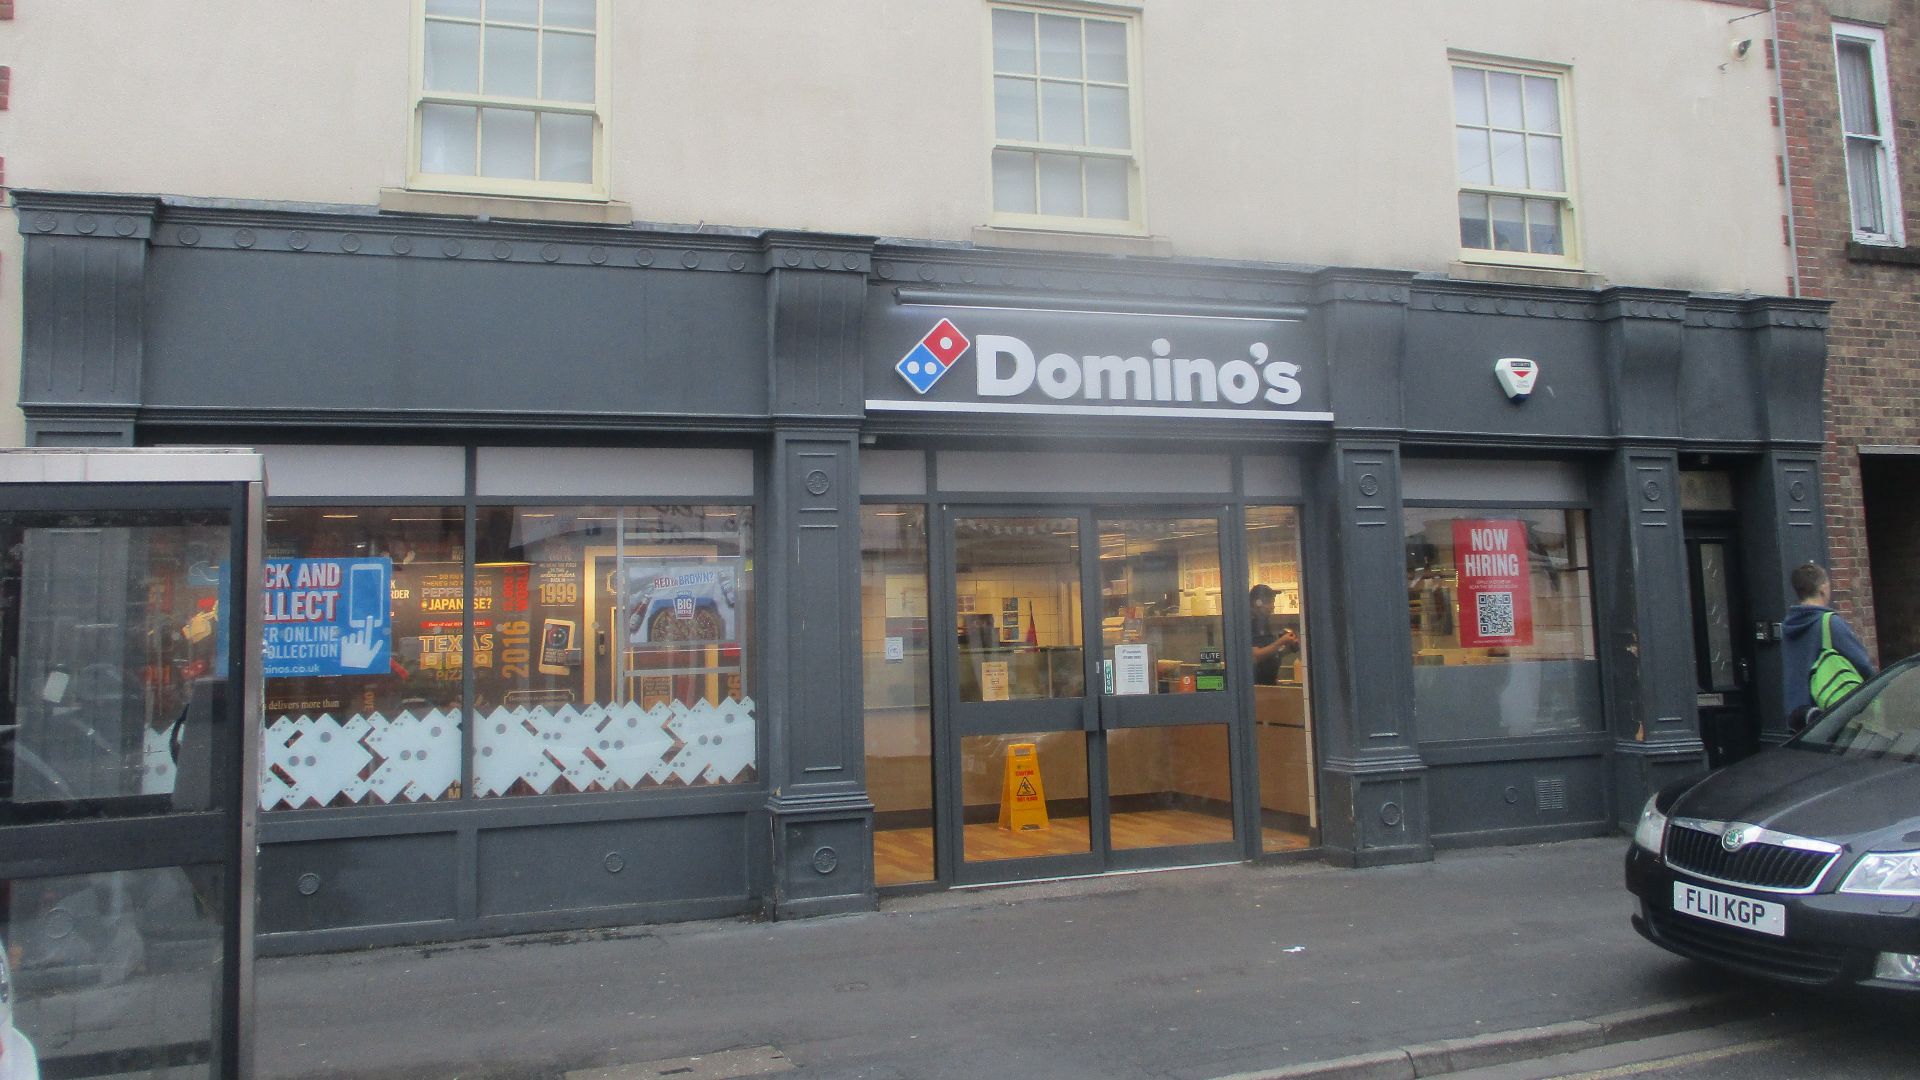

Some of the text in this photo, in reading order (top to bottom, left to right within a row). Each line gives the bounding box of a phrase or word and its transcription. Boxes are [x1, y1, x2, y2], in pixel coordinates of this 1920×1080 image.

[975, 334, 1301, 405] Domino's
[1471, 528, 1508, 551] NOW
[297, 562, 340, 588] AND
[1465, 553, 1519, 577] HIRING
[654, 577, 671, 589] RED
[678, 571, 714, 586] BROWN?
[428, 598, 493, 611] JAPANSE?
[539, 583, 577, 603] 1999
[677, 598, 692, 609] BIG
[284, 625, 339, 642] ONLINE
[502, 621, 530, 679] 2016
[1105, 667, 1113, 690] PUSH
[269, 701, 300, 710] delivers
[301, 700, 321, 709] more
[322, 699, 340, 708] than
[1686, 887, 1765, 926] FL11 KGP
